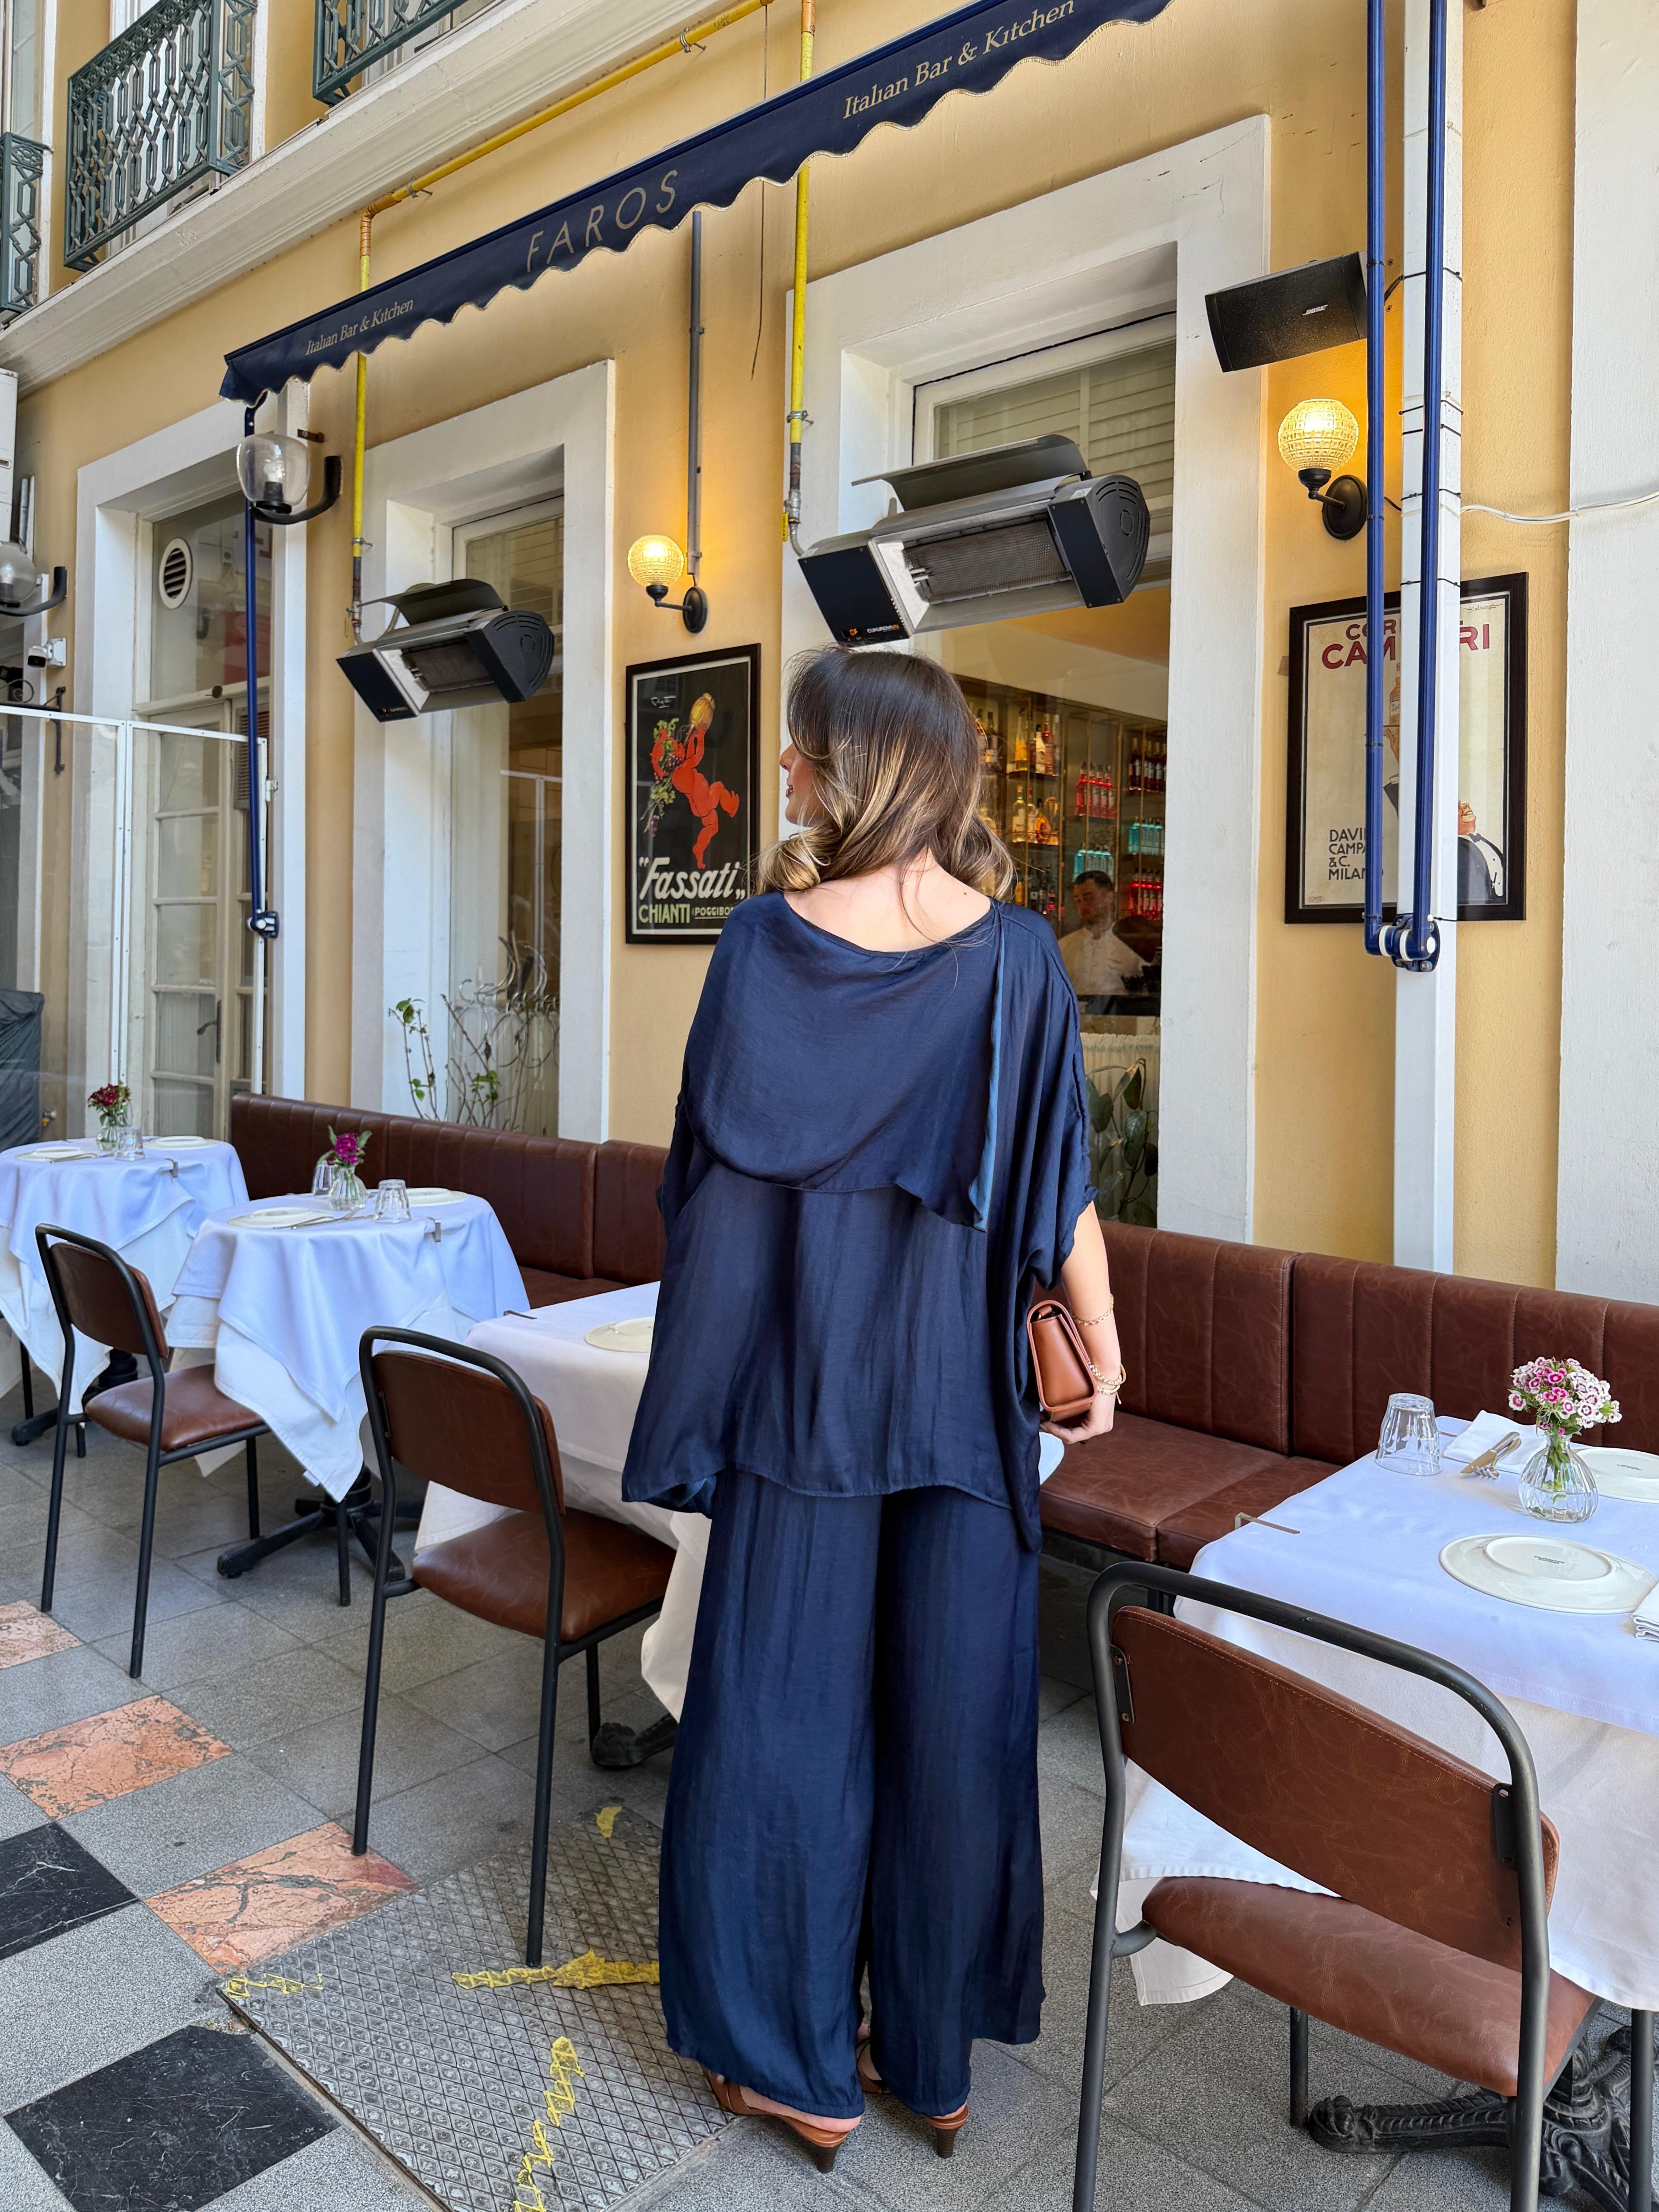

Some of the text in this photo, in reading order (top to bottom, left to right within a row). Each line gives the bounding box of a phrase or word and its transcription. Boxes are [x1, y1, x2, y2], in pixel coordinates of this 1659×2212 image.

[914, 56, 953, 87] Bar
[958, 41, 978, 65] &
[527, 170, 678, 272] FAROS
[340, 324, 359, 341] Bar
[359, 316, 370, 332] &
[638, 903, 690, 924] CHIANTI
